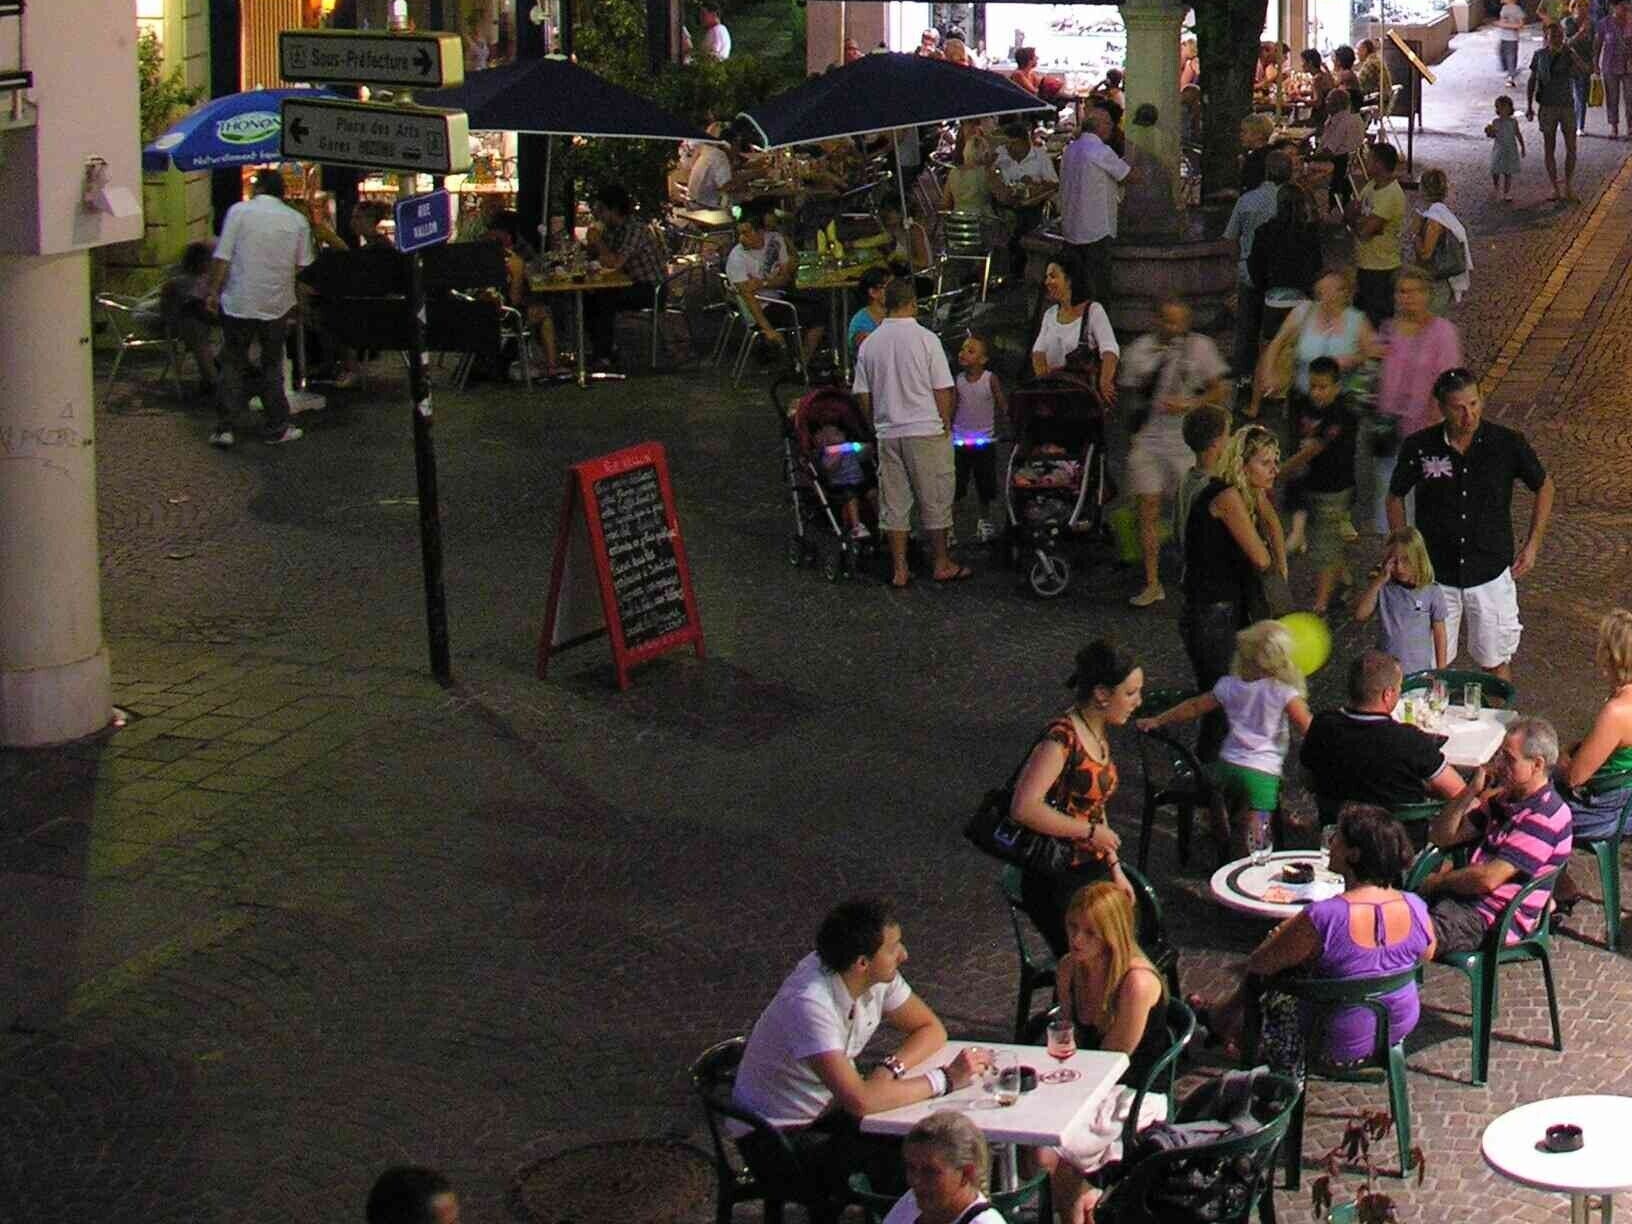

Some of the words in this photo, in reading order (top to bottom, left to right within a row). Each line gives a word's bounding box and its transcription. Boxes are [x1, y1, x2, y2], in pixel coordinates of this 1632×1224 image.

[310, 47, 409, 70] Sous-Préfecture
[336, 117, 366, 133] Place
[369, 119, 390, 136] des
[395, 120, 419, 138] Arts
